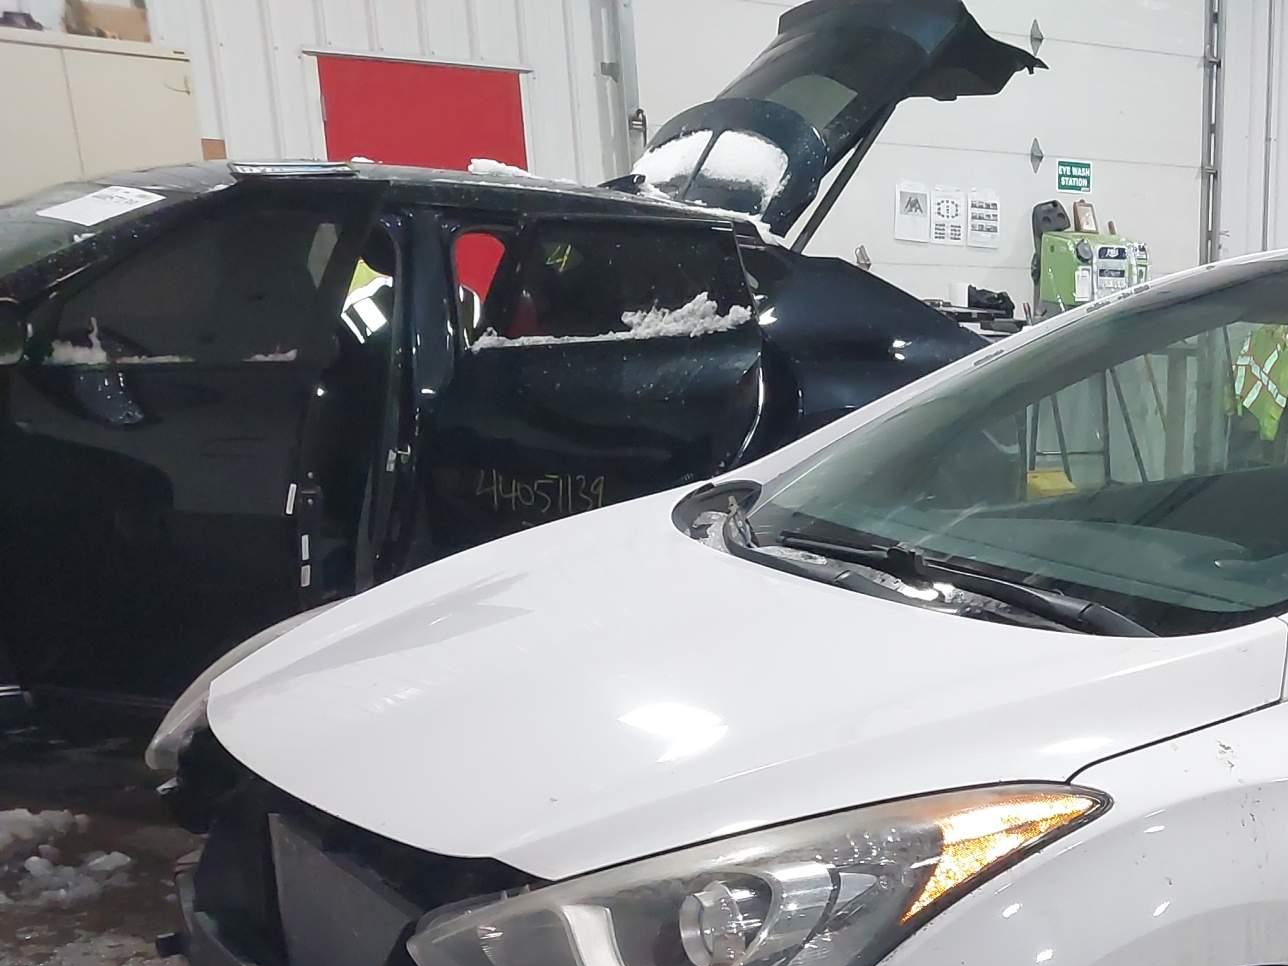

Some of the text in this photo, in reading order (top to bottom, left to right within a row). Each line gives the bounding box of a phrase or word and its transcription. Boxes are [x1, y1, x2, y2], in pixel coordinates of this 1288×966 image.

[1059, 165, 1090, 177] EYE WASH
[1060, 177, 1088, 187] STATION
